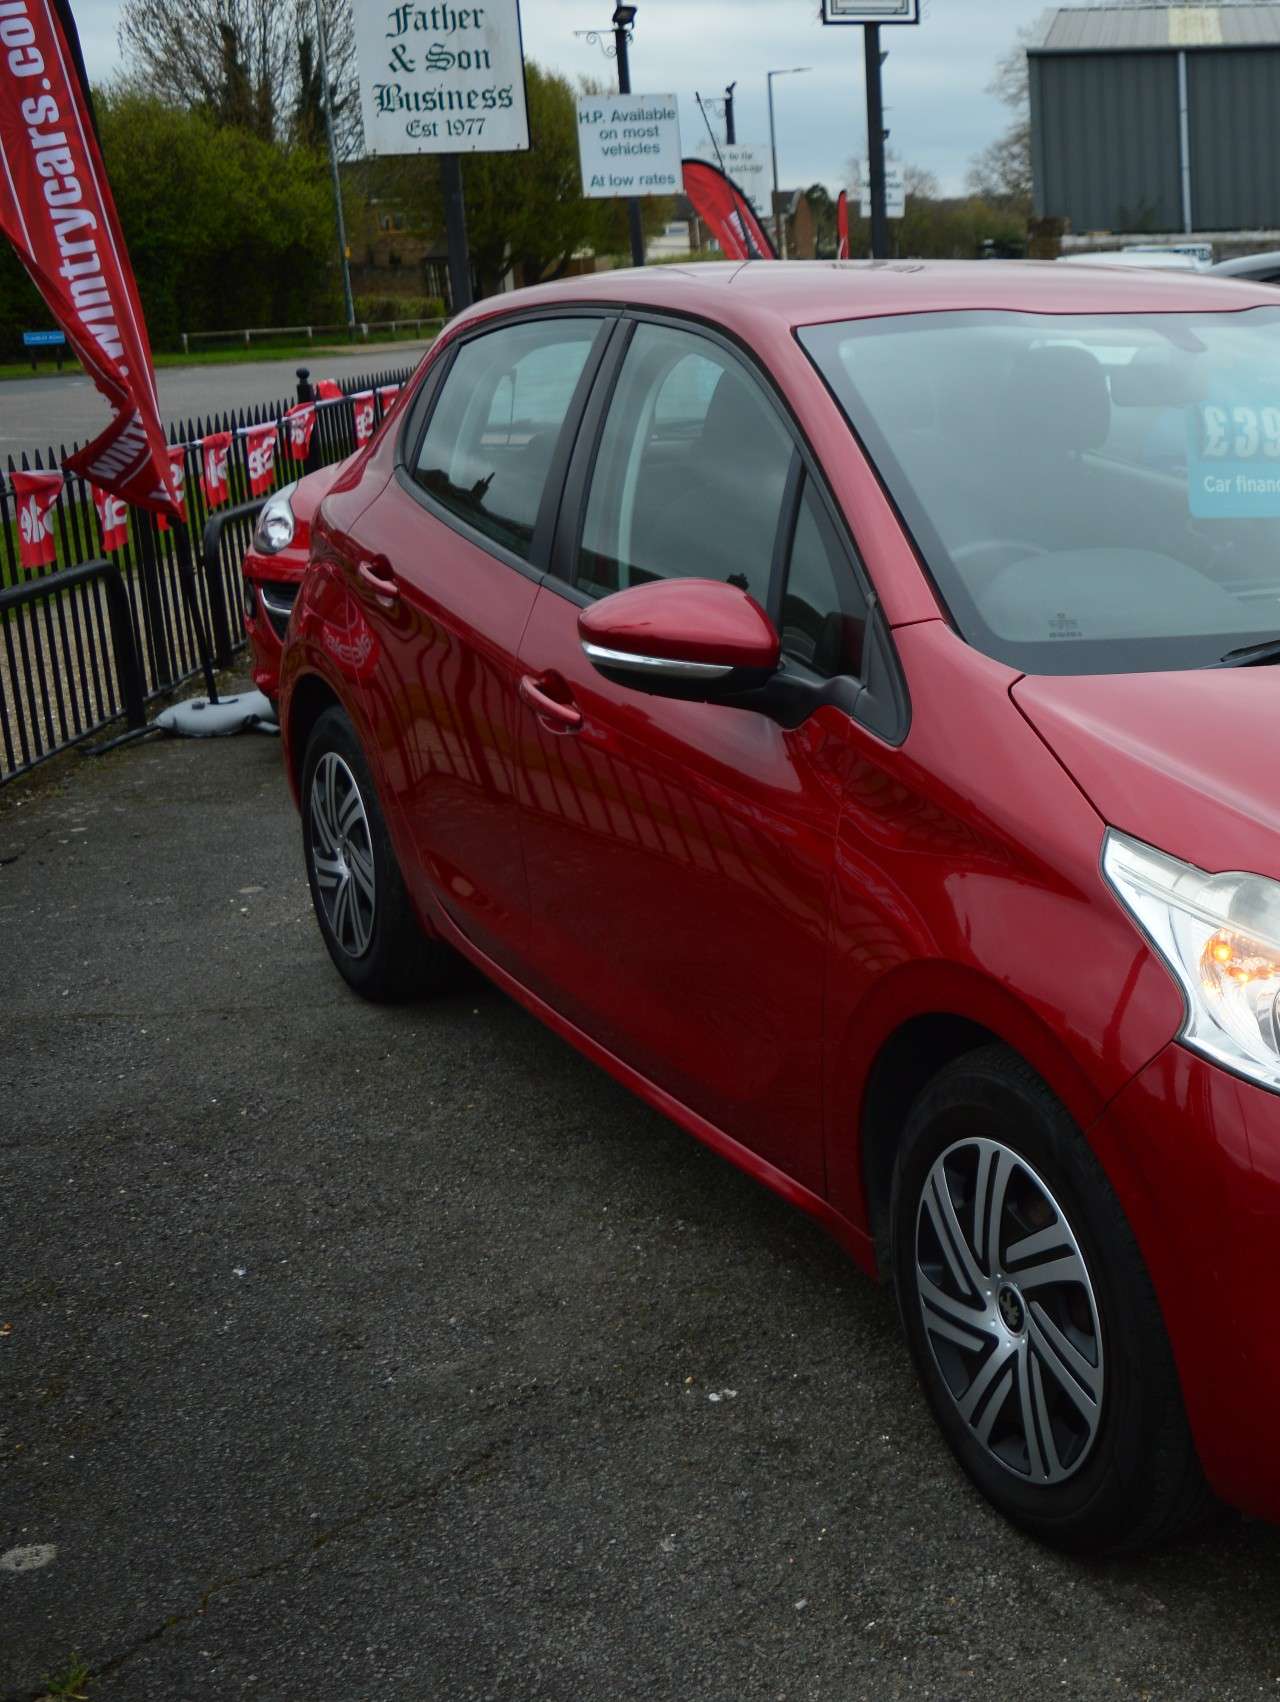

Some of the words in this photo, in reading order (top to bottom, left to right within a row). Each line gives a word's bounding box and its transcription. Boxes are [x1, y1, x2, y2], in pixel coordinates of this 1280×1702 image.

[385, 3, 485, 39] Father
[388, 44, 416, 73] &
[425, 43, 491, 72] Son
[373, 81, 513, 118] Business
[579, 112, 605, 124] H.P.
[611, 108, 676, 122] Available
[406, 119, 439, 138] Est
[446, 118, 486, 137] 1977
[599, 128, 618, 139] on
[623, 126, 660, 138] most
[601, 143, 661, 157] vehicles
[590, 175, 605, 187] At
[609, 174, 633, 186] low
[639, 174, 676, 186] rates
[1204, 476, 1232, 493] Car
